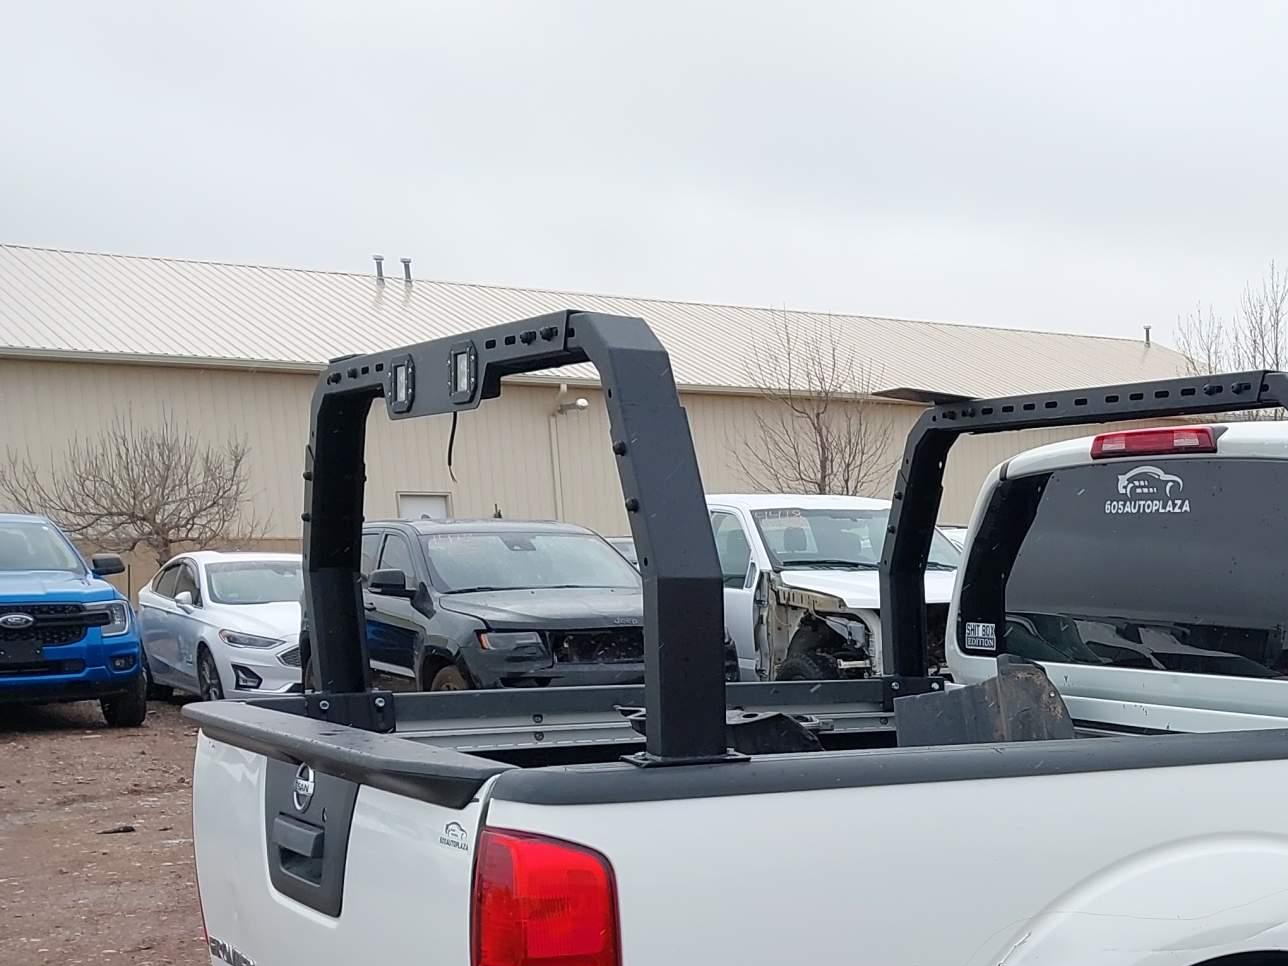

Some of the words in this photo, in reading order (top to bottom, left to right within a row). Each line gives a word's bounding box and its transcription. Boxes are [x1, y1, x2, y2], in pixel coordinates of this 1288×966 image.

[1104, 500, 1191, 514] 605AUTOPLAZA
[967, 624, 980, 636] SHIT
[967, 638, 994, 647] EDITION
